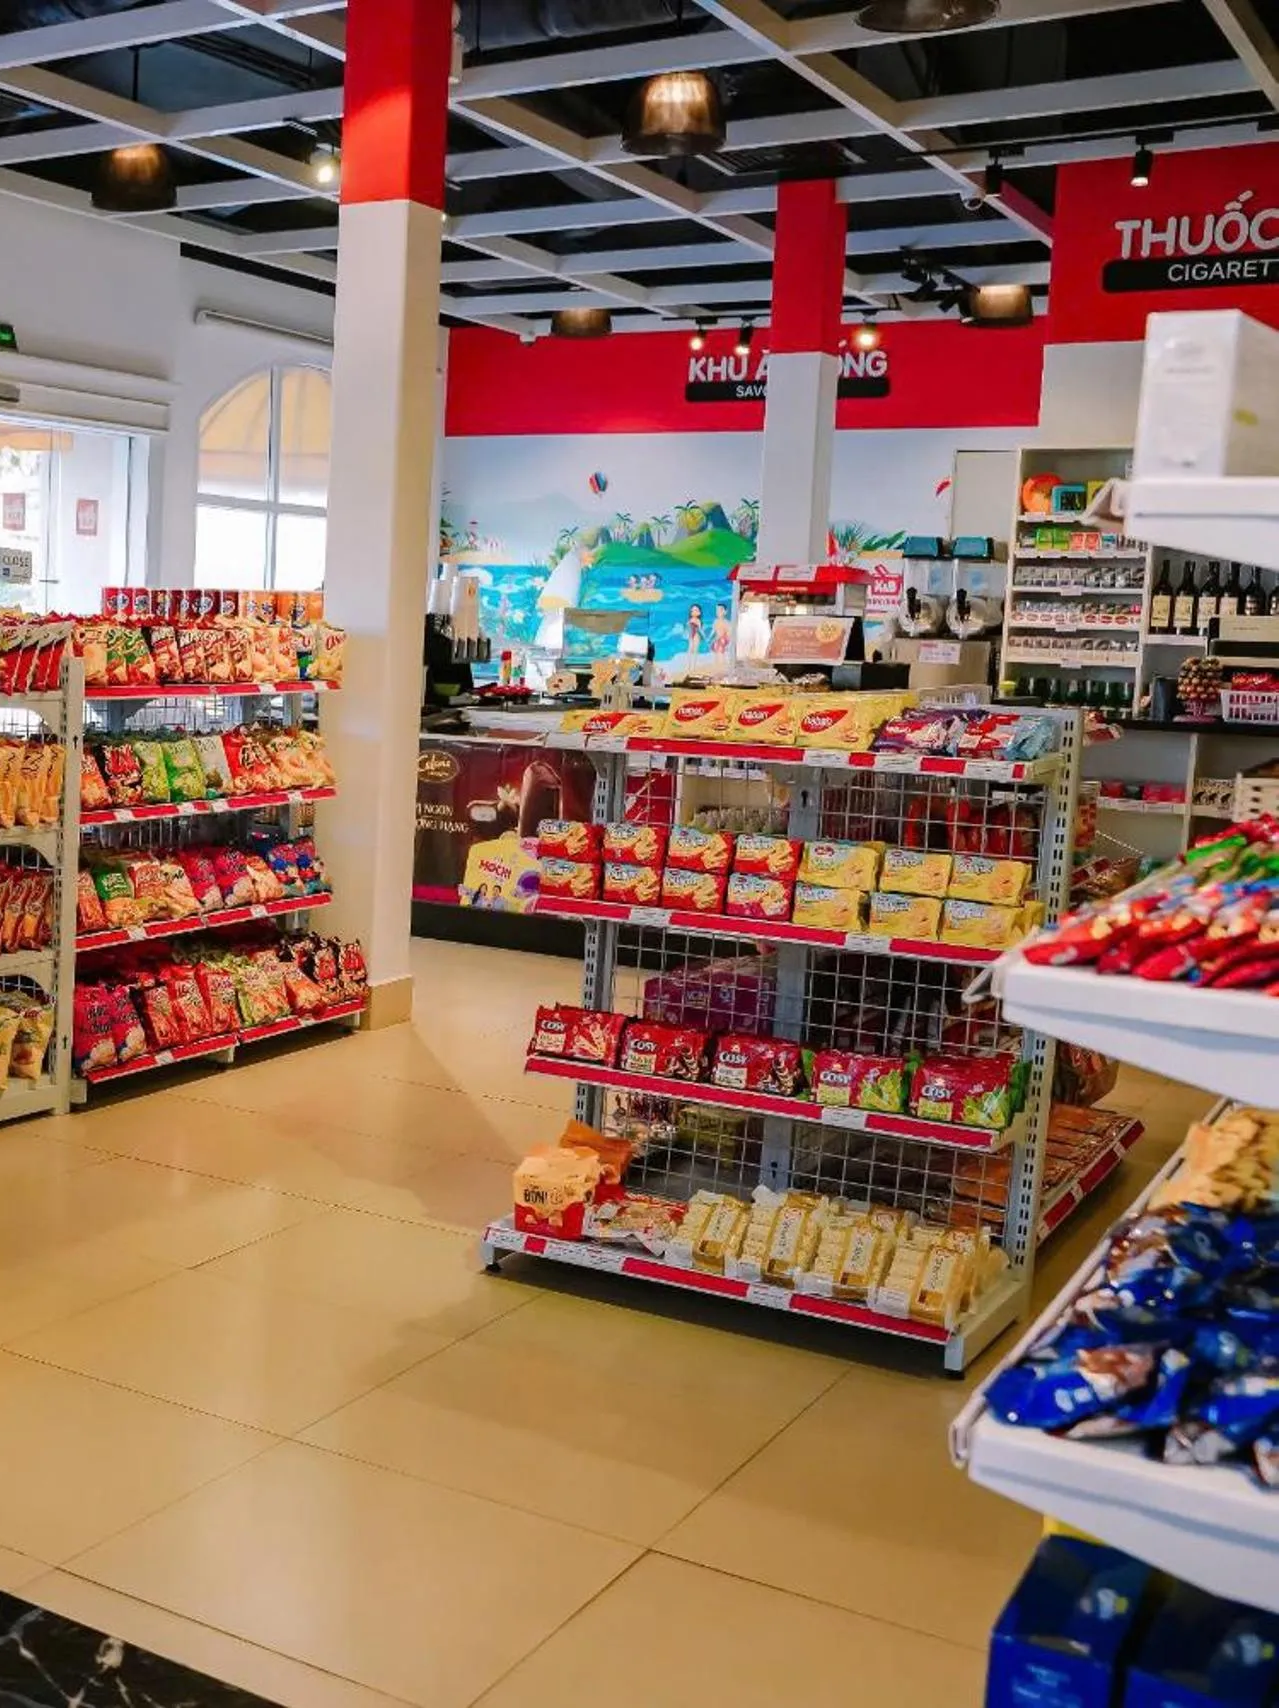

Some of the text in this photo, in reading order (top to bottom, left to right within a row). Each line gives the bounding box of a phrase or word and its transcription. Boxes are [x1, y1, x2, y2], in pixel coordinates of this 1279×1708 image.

[1114, 190, 1279, 260] THUỐC
[688, 353, 748, 382] KHU
[735, 384, 768, 399] SAV
